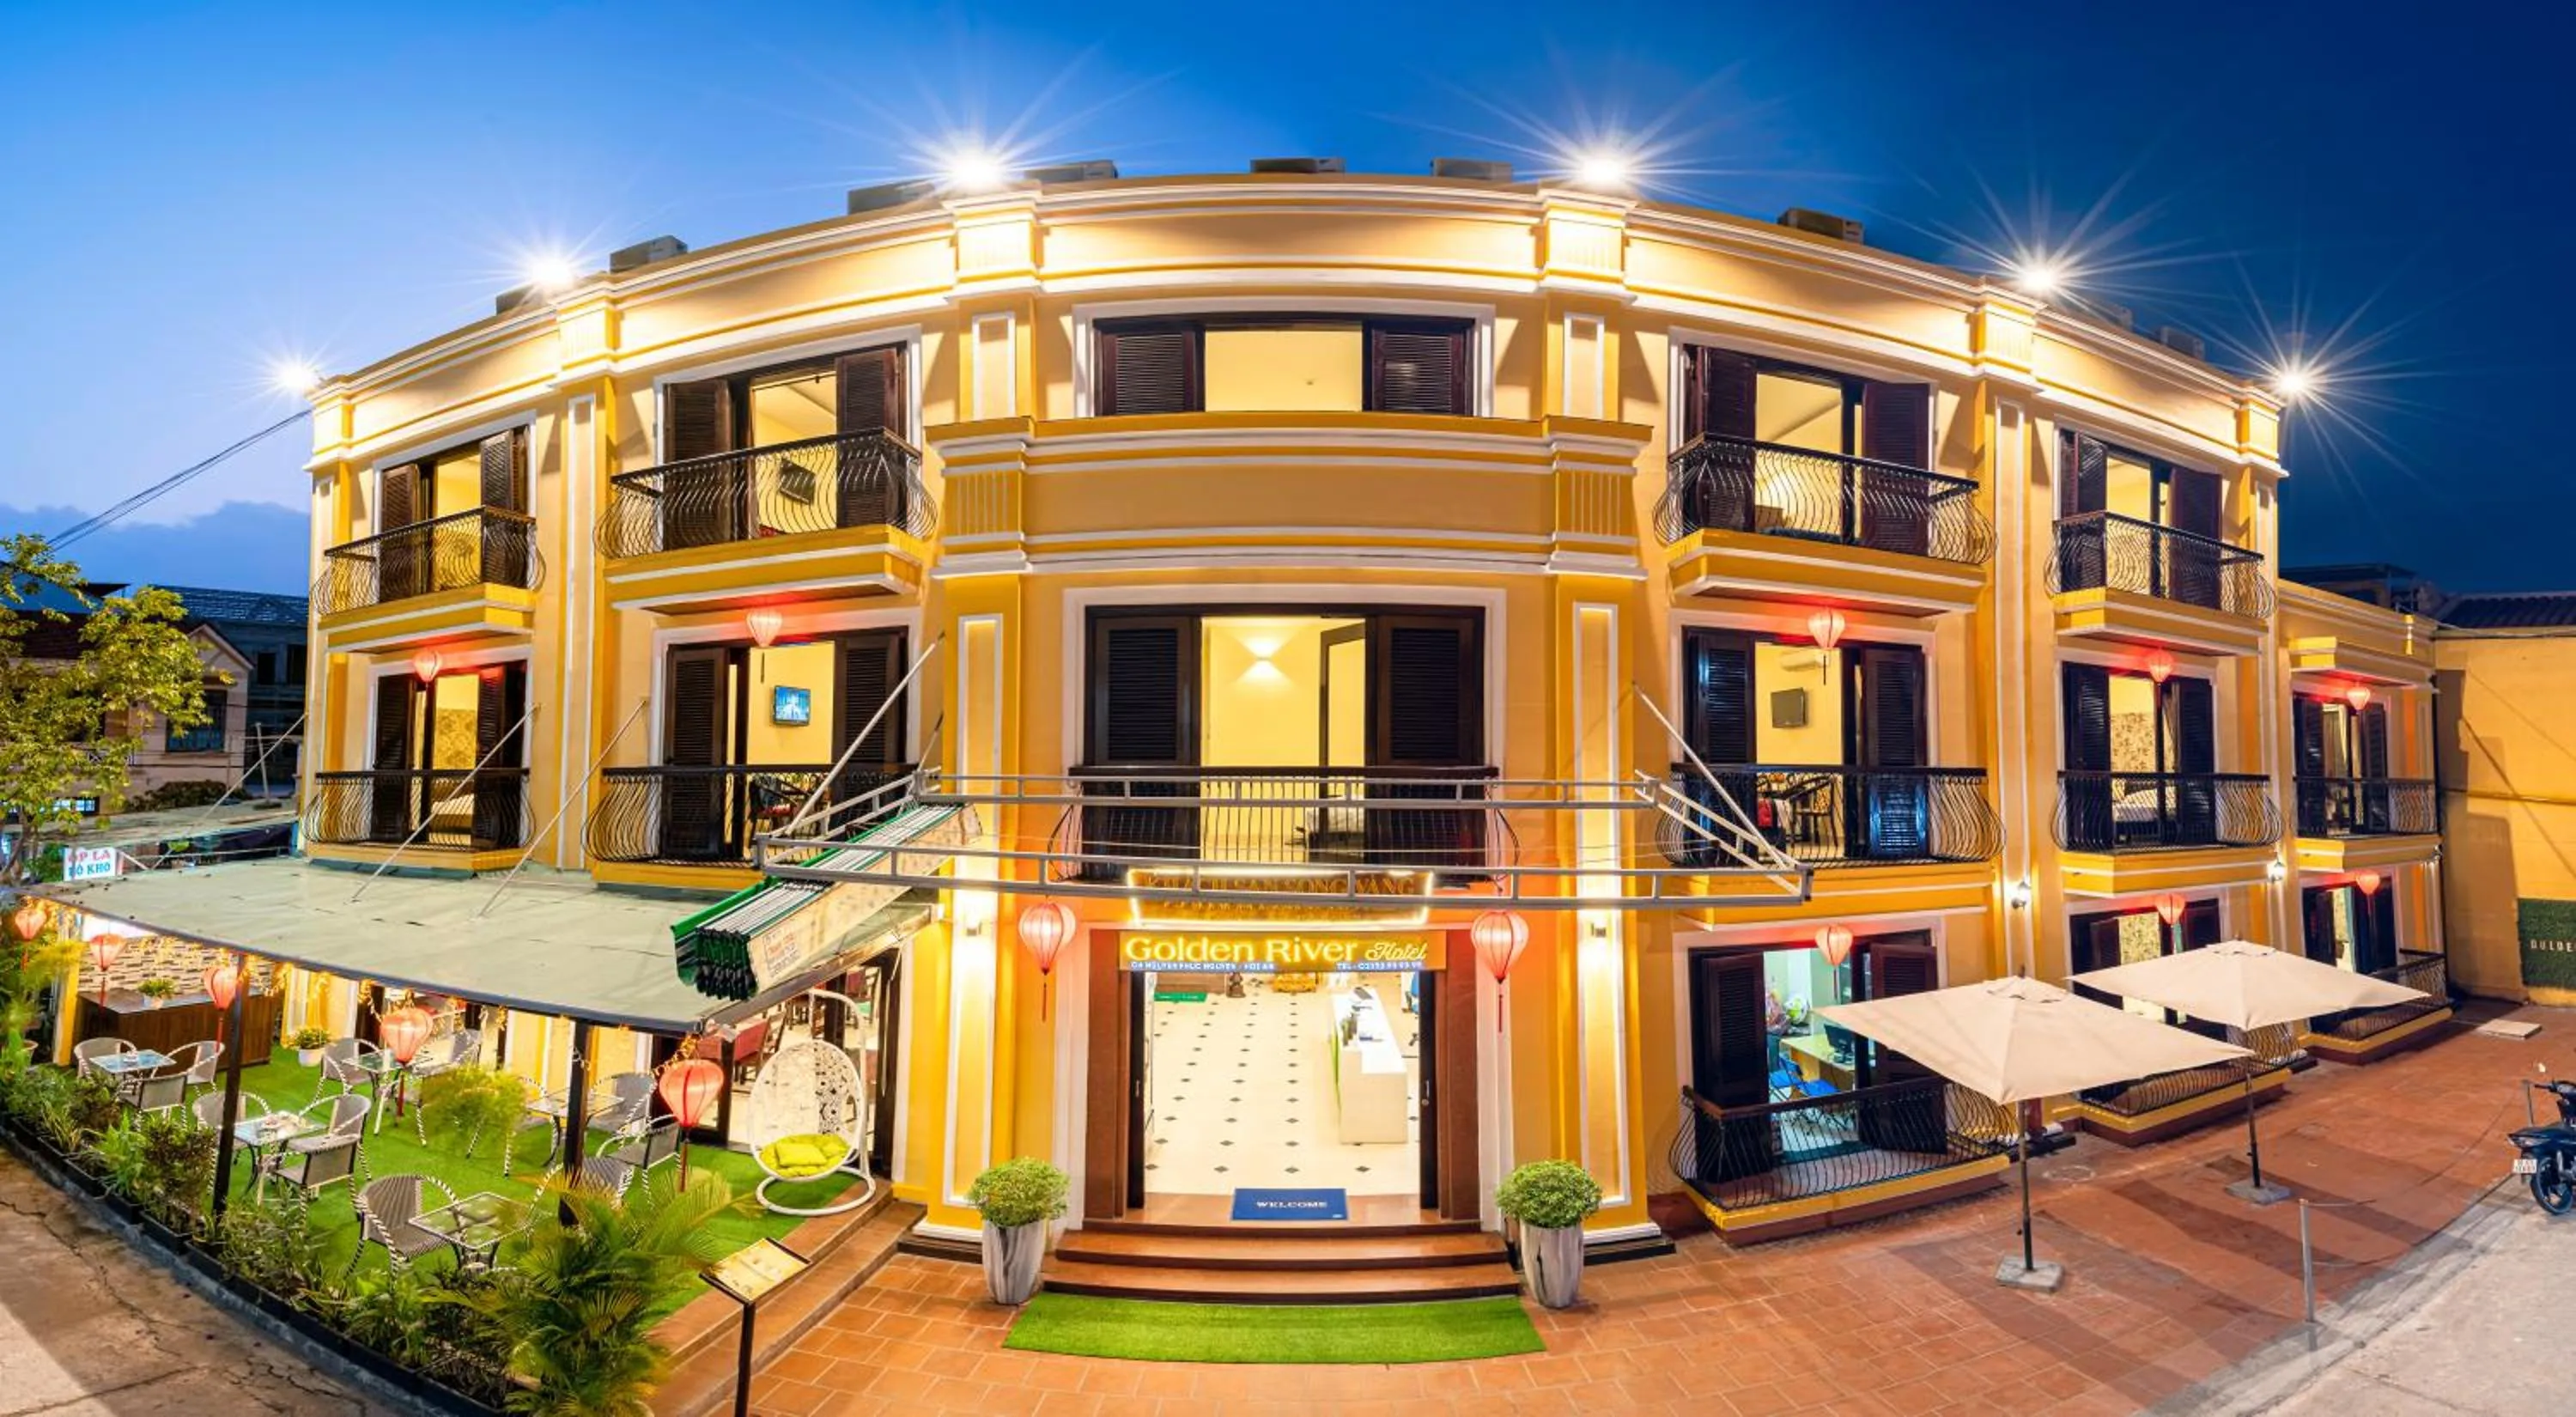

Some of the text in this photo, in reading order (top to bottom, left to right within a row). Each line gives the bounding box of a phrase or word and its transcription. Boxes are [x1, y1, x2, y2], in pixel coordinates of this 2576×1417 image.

[1126, 935, 1428, 962] Golden River Hotel
[2530, 939, 2576, 952] GOLDE
[1256, 1200, 1328, 1209] WELCOME
